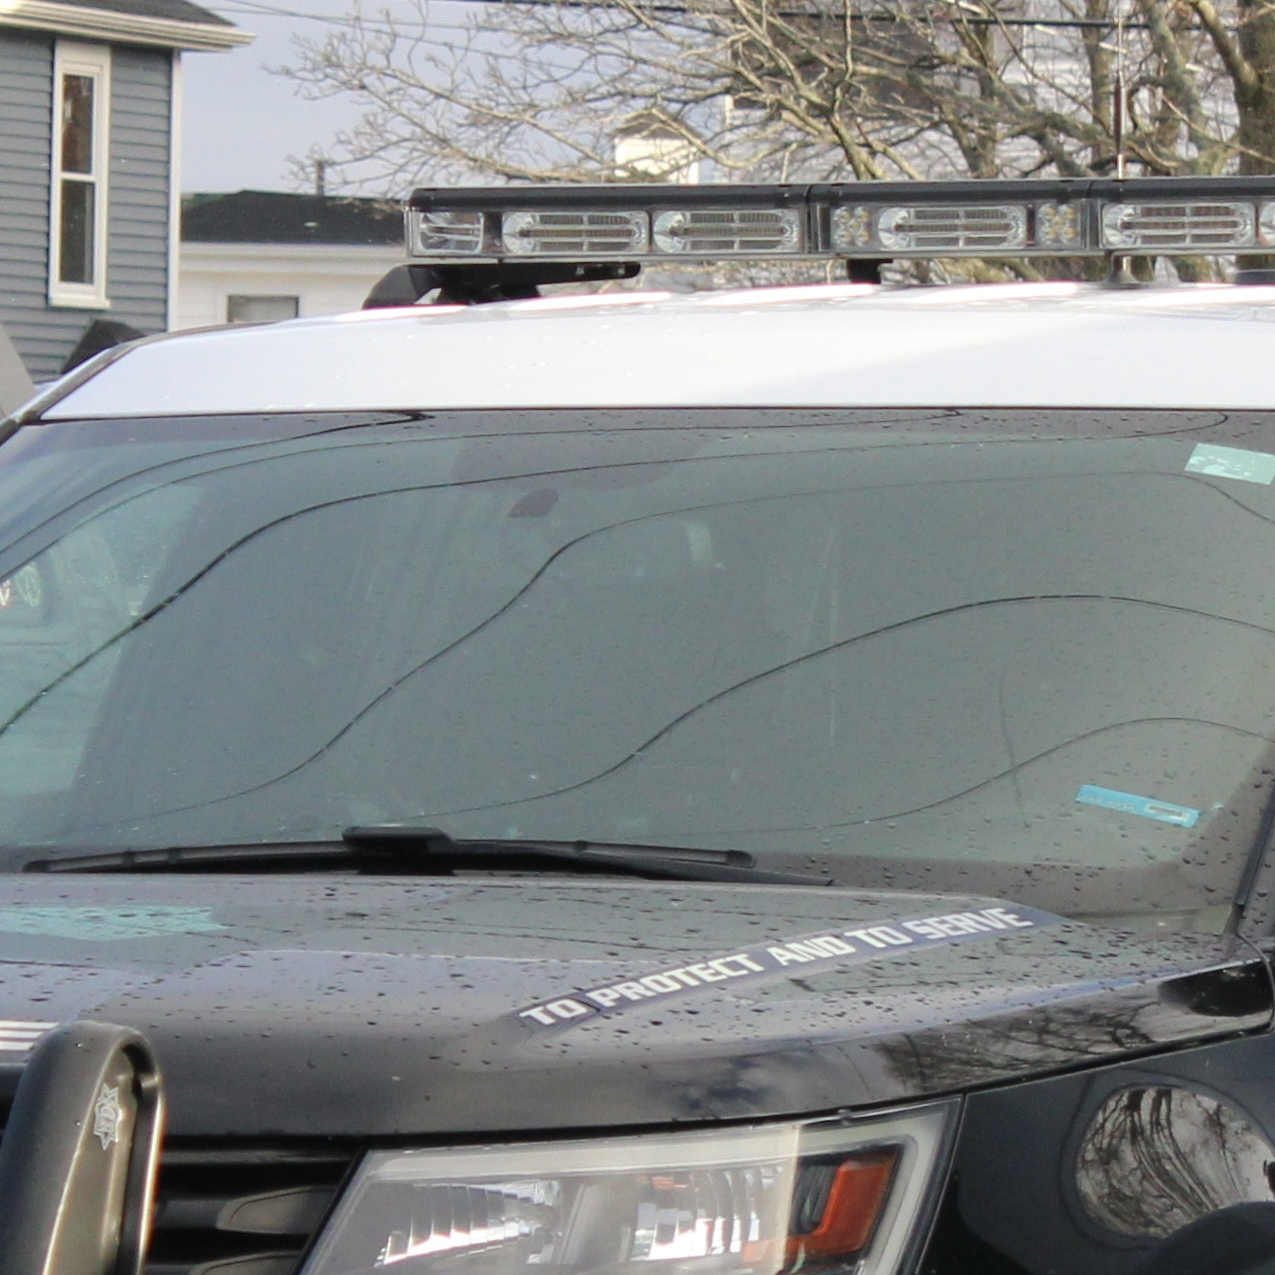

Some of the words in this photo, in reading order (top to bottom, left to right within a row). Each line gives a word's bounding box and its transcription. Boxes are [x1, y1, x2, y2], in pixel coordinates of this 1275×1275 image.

[519, 998, 589, 1026] TO
[585, 953, 765, 1008] PROTECT
[766, 935, 857, 967] AND
[843, 925, 913, 949] TO
[901, 907, 1034, 940] SERVE
